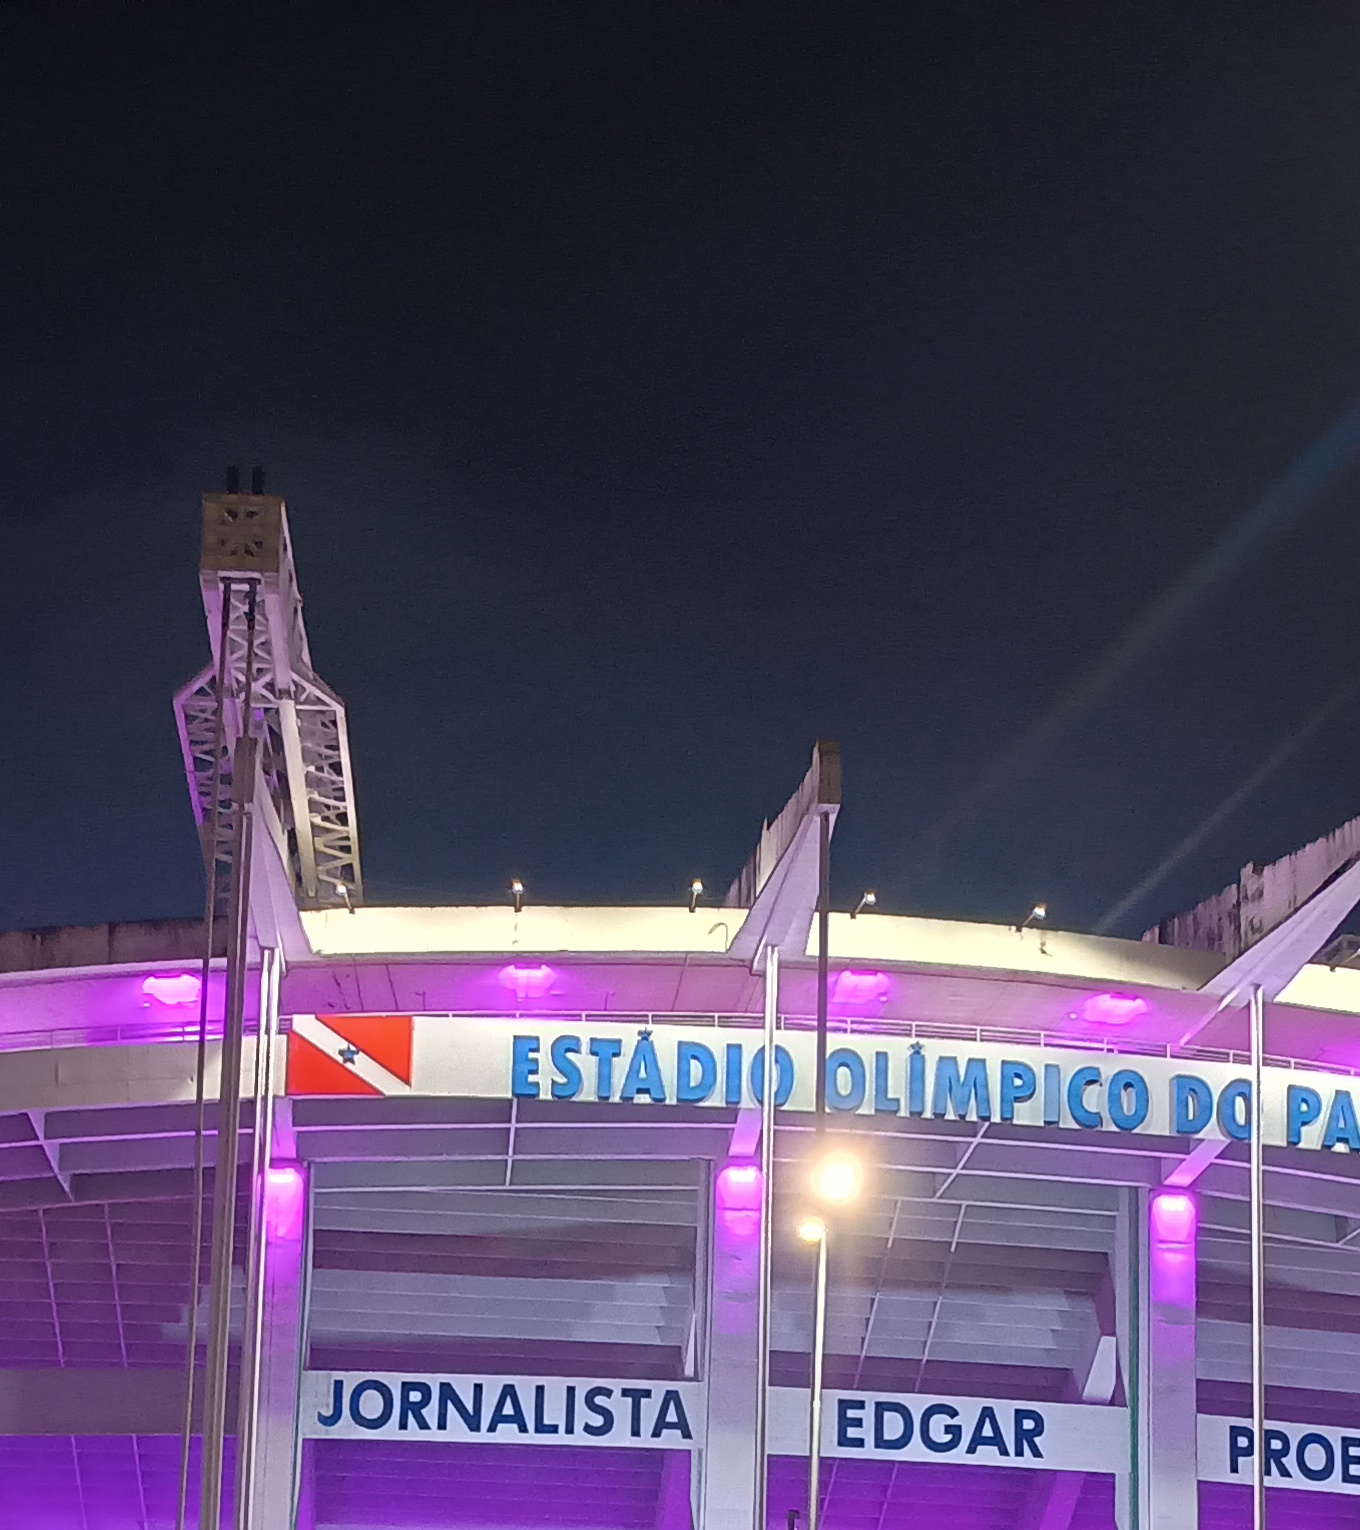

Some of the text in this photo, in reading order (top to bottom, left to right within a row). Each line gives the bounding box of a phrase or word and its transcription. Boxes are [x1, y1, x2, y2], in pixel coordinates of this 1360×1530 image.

[512, 1027, 794, 1108] ESTÁDIO
[823, 1038, 1149, 1131] OLÍMPICO
[1168, 1072, 1255, 1142] DO
[316, 1378, 693, 1441] JORNALISTA
[836, 1399, 1046, 1459] EDGAR
